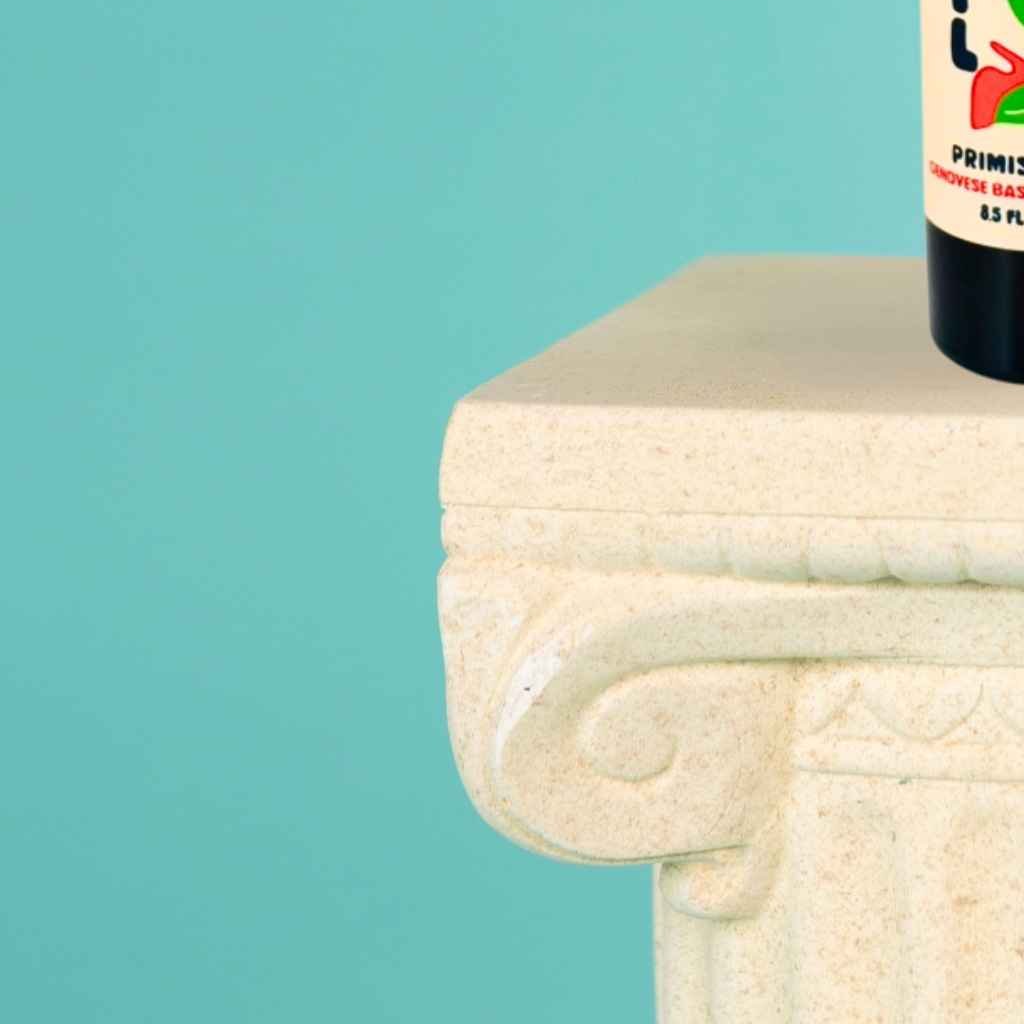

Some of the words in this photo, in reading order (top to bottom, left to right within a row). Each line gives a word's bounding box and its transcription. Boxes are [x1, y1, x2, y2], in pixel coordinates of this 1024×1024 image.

[930, 160, 987, 194] GENOVESE
[980, 204, 1001, 223] 8.5
[1007, 210, 1024, 226] FL
